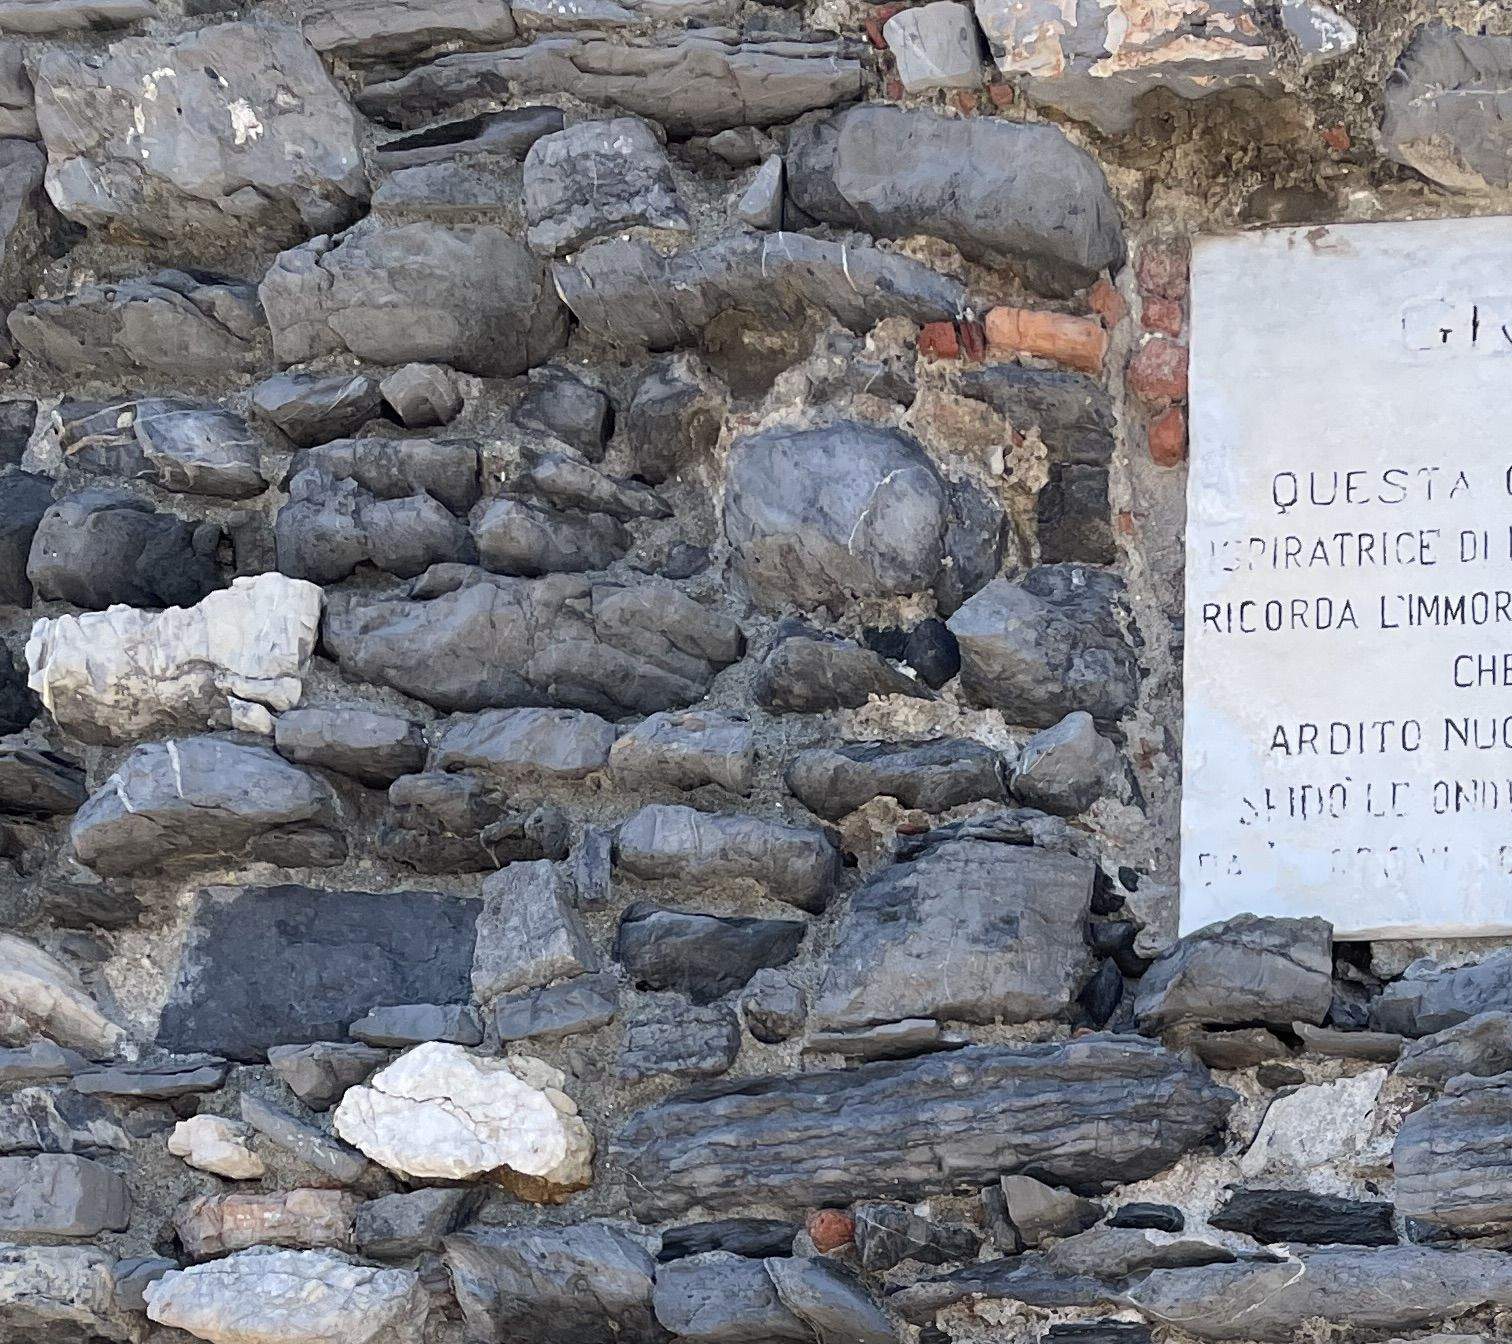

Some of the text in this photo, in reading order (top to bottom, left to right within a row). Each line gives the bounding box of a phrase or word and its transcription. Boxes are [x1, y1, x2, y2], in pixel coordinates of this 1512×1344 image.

[1272, 465, 1473, 515] QUESTA
[1460, 528, 1489, 564] DI
[1203, 597, 1358, 634] RICORDA
[1268, 719, 1422, 756] ARDITO
